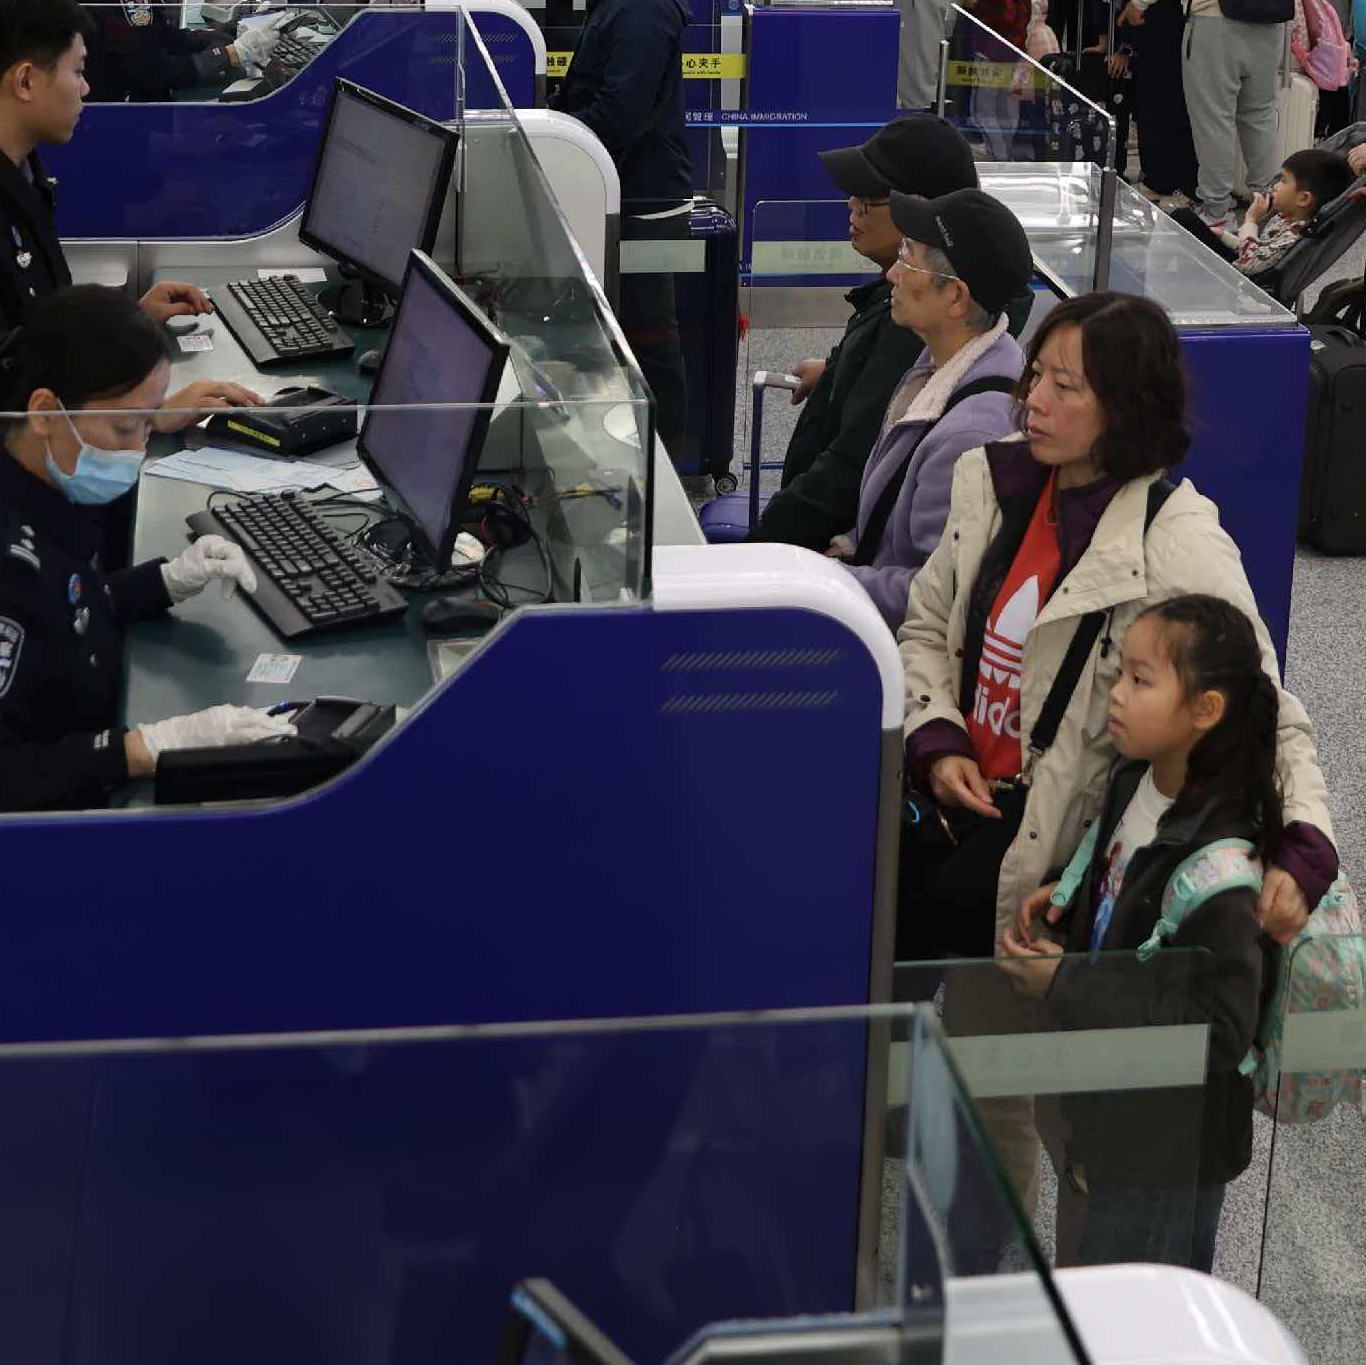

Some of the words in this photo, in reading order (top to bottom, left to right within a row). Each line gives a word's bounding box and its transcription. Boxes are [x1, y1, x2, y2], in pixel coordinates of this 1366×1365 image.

[682, 58, 722, 69] 心夹手
[750, 112, 808, 121] IMMIGRATION
